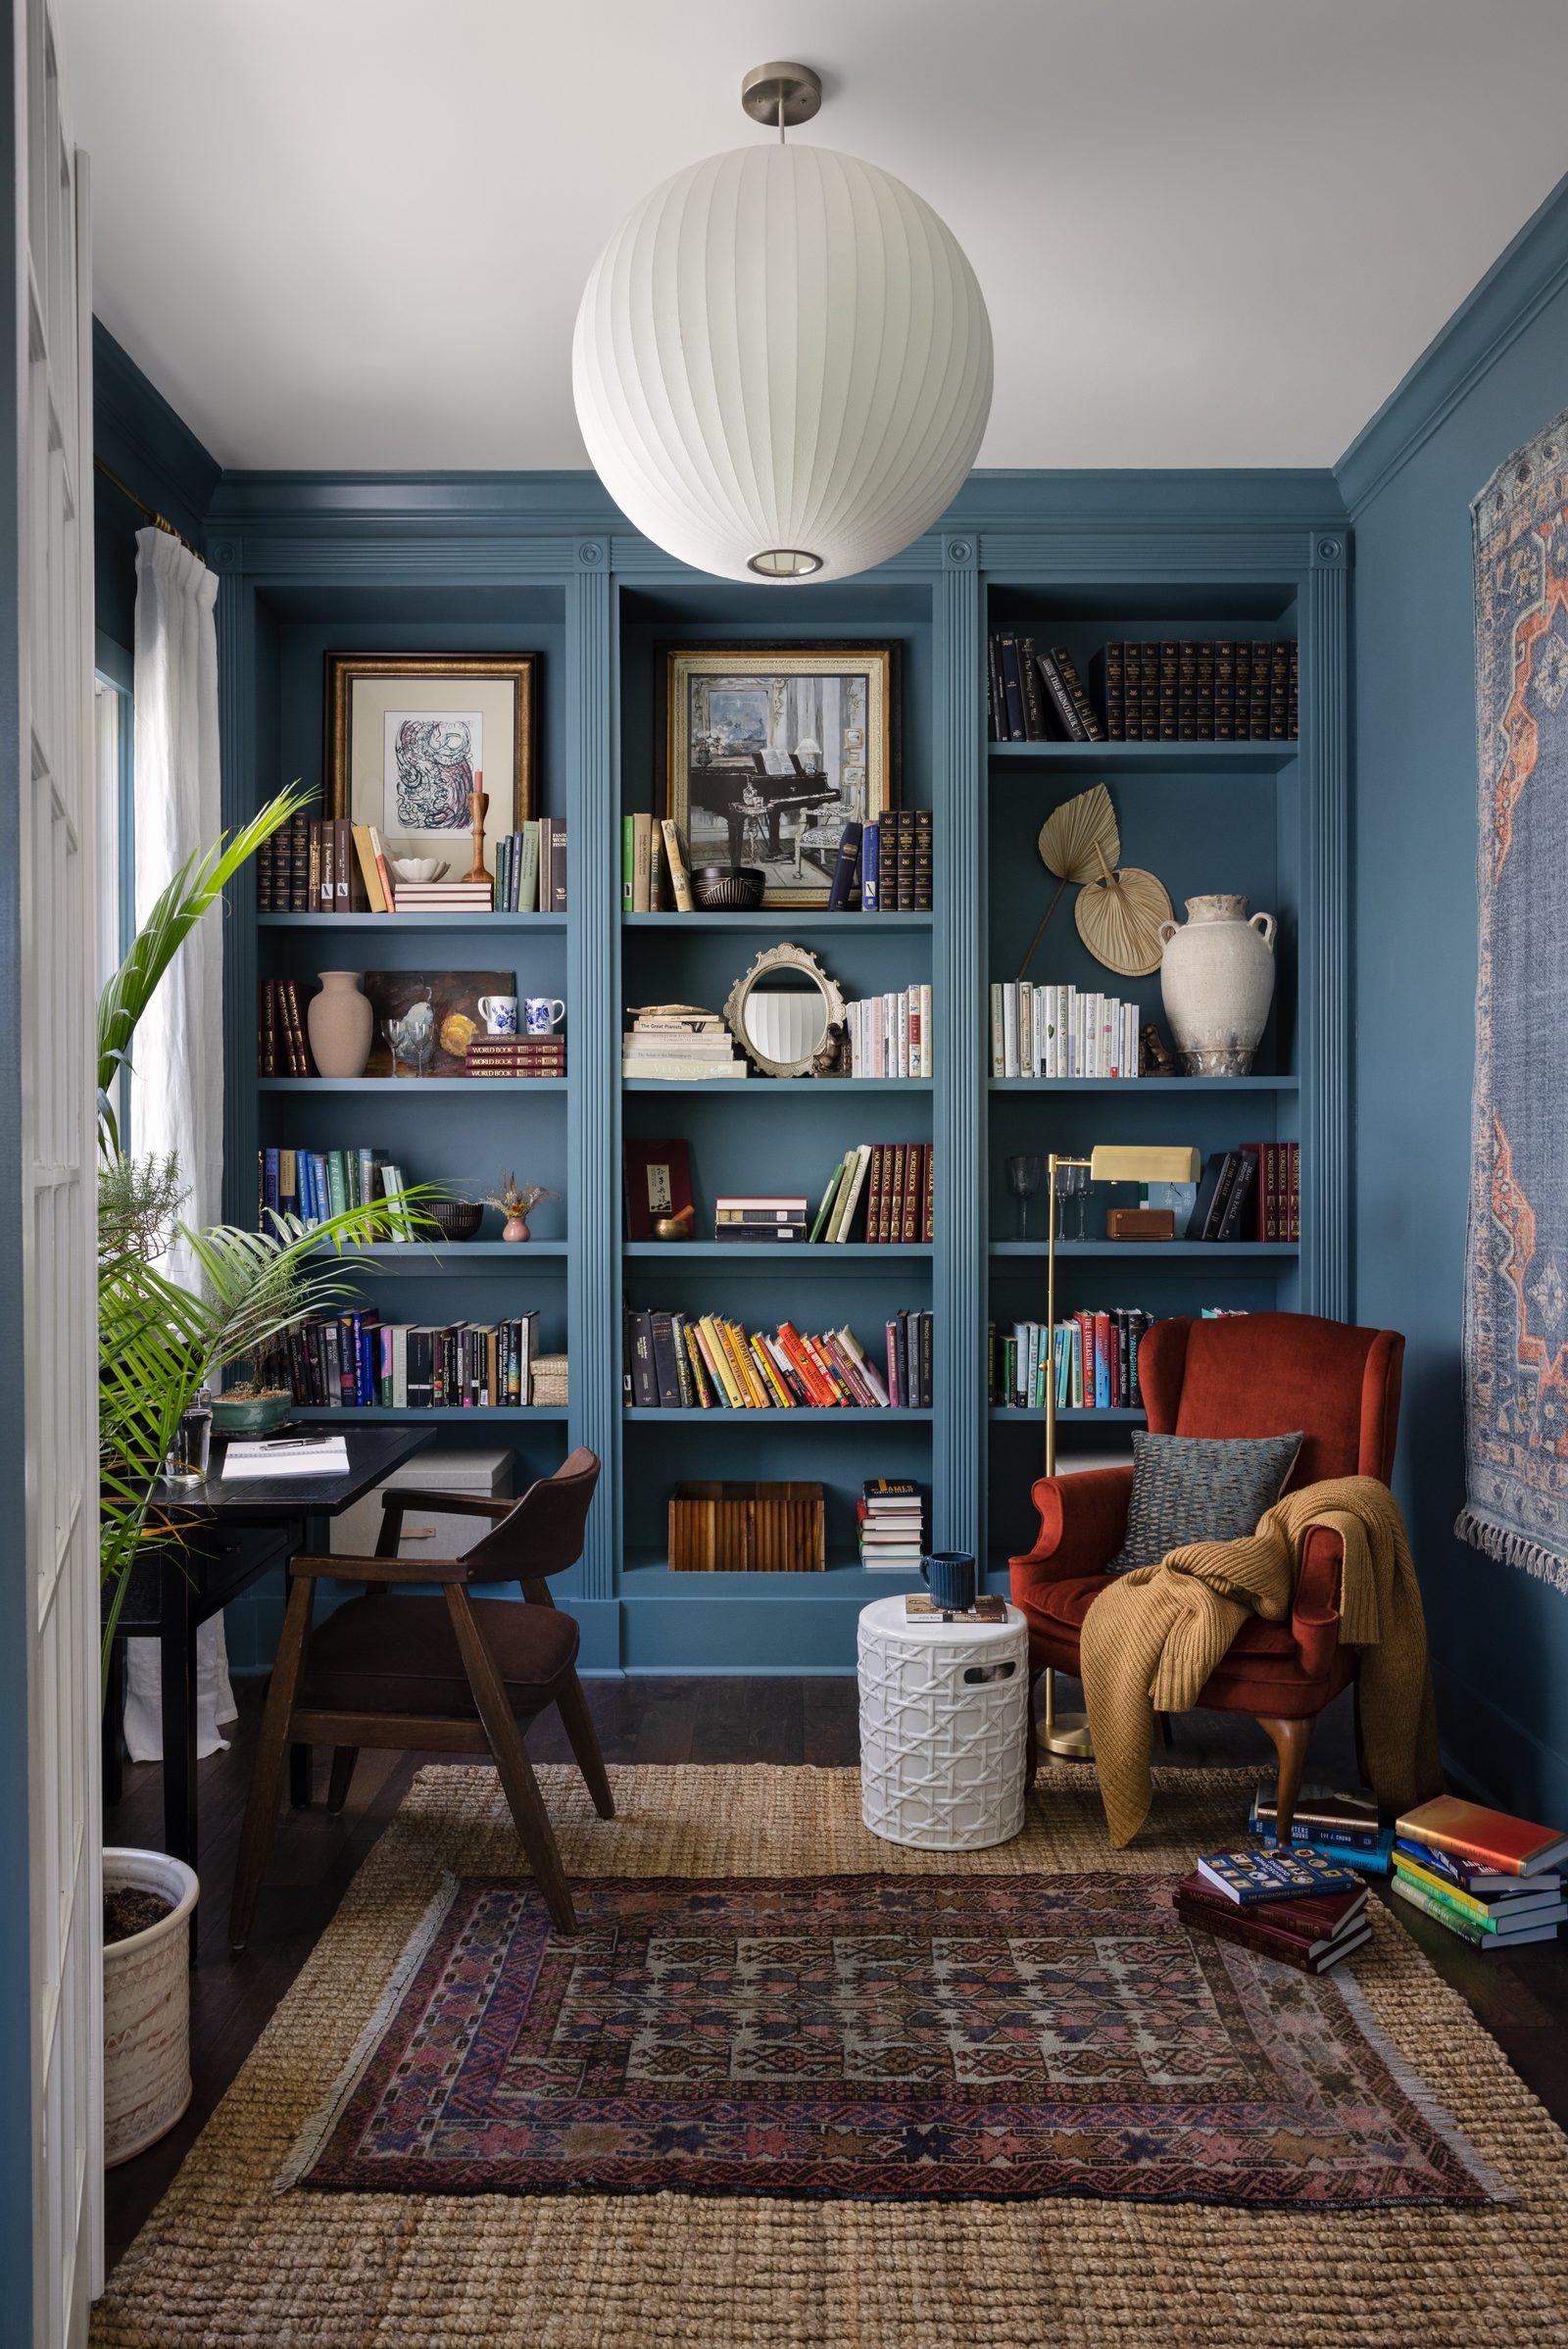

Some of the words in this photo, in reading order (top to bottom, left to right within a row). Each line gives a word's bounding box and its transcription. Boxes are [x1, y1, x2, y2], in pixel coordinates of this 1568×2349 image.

[1051, 676, 1062, 690] THE
[1057, 690, 1077, 727] MINOTAUR
[331, 1158, 341, 1200] TRUST
[852, 1160, 863, 1191] MUSICAL
[1239, 1161, 1248, 1182] KOONTZ
[846, 1194, 854, 1214] STYLE
[1229, 1201, 1239, 1219] FACE
[716, 1322, 727, 1342] MEMPHIS
[732, 1364, 748, 1396] STRINGFELLOW
[733, 1330, 755, 1372] AFTERPARTIES
[803, 1340, 815, 1354] STAY
[811, 1352, 822, 1367] WITH
[837, 1378, 846, 1388] JANE
[1254, 1856, 1289, 1882] PHILOSOPHER
[1268, 1860, 1290, 1877] QUEENS
[1189, 1892, 1222, 1906] WORLD
[1224, 1901, 1250, 1913] BOOK
